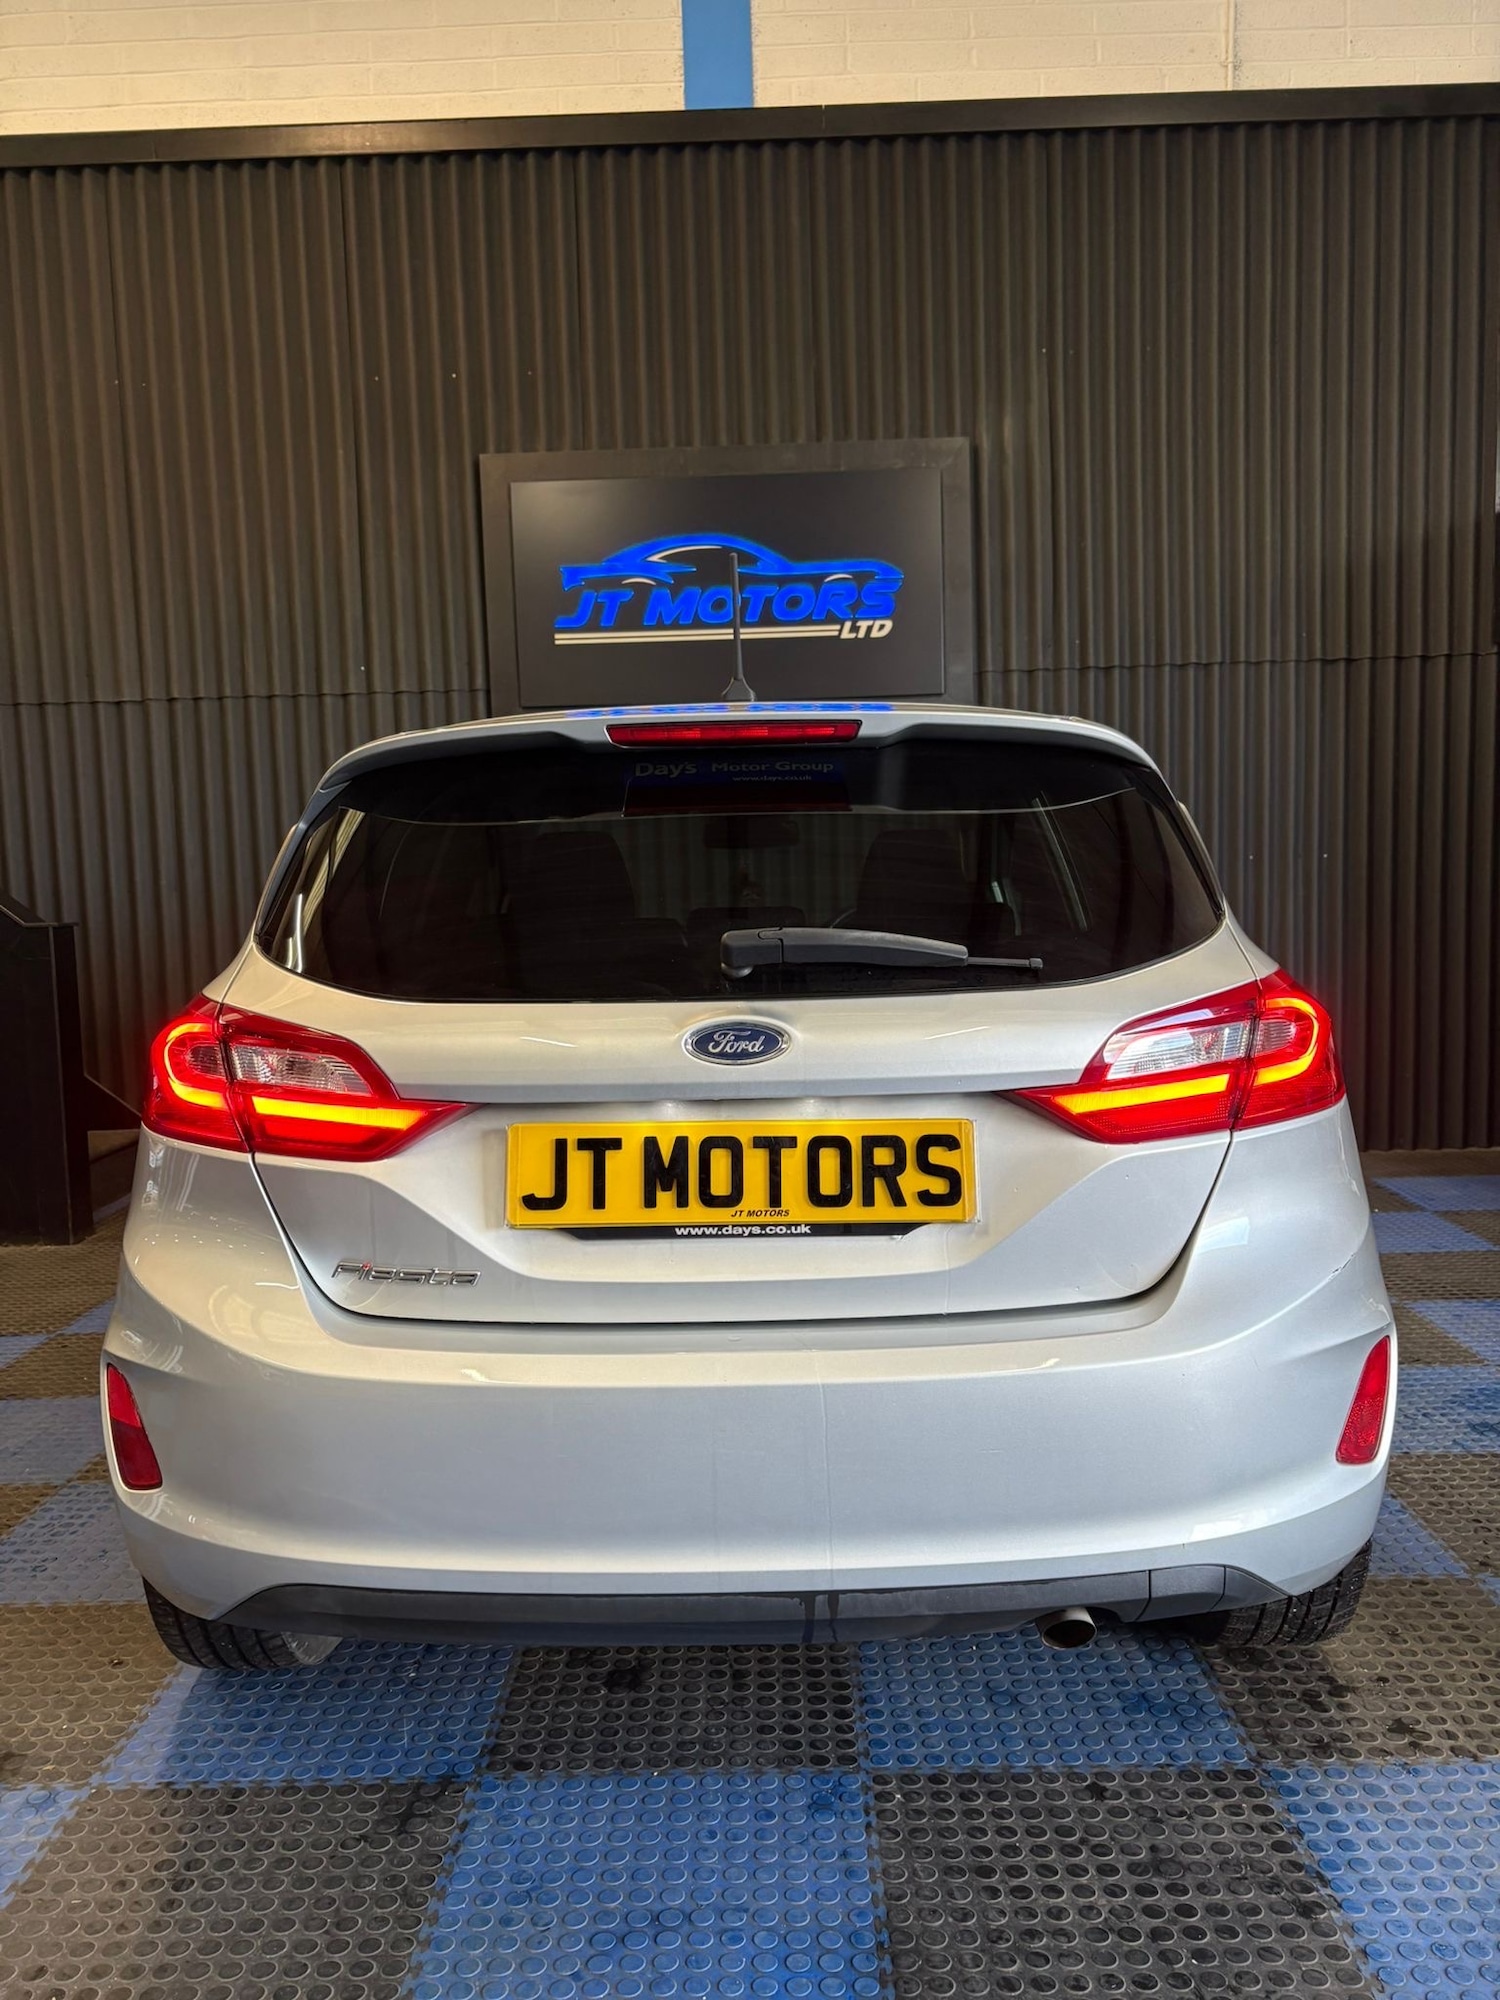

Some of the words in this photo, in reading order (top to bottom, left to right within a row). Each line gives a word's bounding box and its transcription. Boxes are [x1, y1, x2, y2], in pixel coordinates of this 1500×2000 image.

[554, 589, 634, 628] JT
[643, 581, 903, 626] MOTORS
[839, 619, 893, 640] LTD
[635, 762, 697, 777] Day's
[712, 762, 769, 773] Motor
[775, 761, 834, 772] Group
[708, 1030, 765, 1053] Ford
[521, 1137, 622, 1211] JT
[643, 1134, 962, 1208] MOTORS
[730, 1209, 744, 1218] JT
[746, 1209, 790, 1217] MOTORS
[675, 1223, 812, 1237] www.days.co.uk
[331, 1260, 481, 1287] Fiesta
